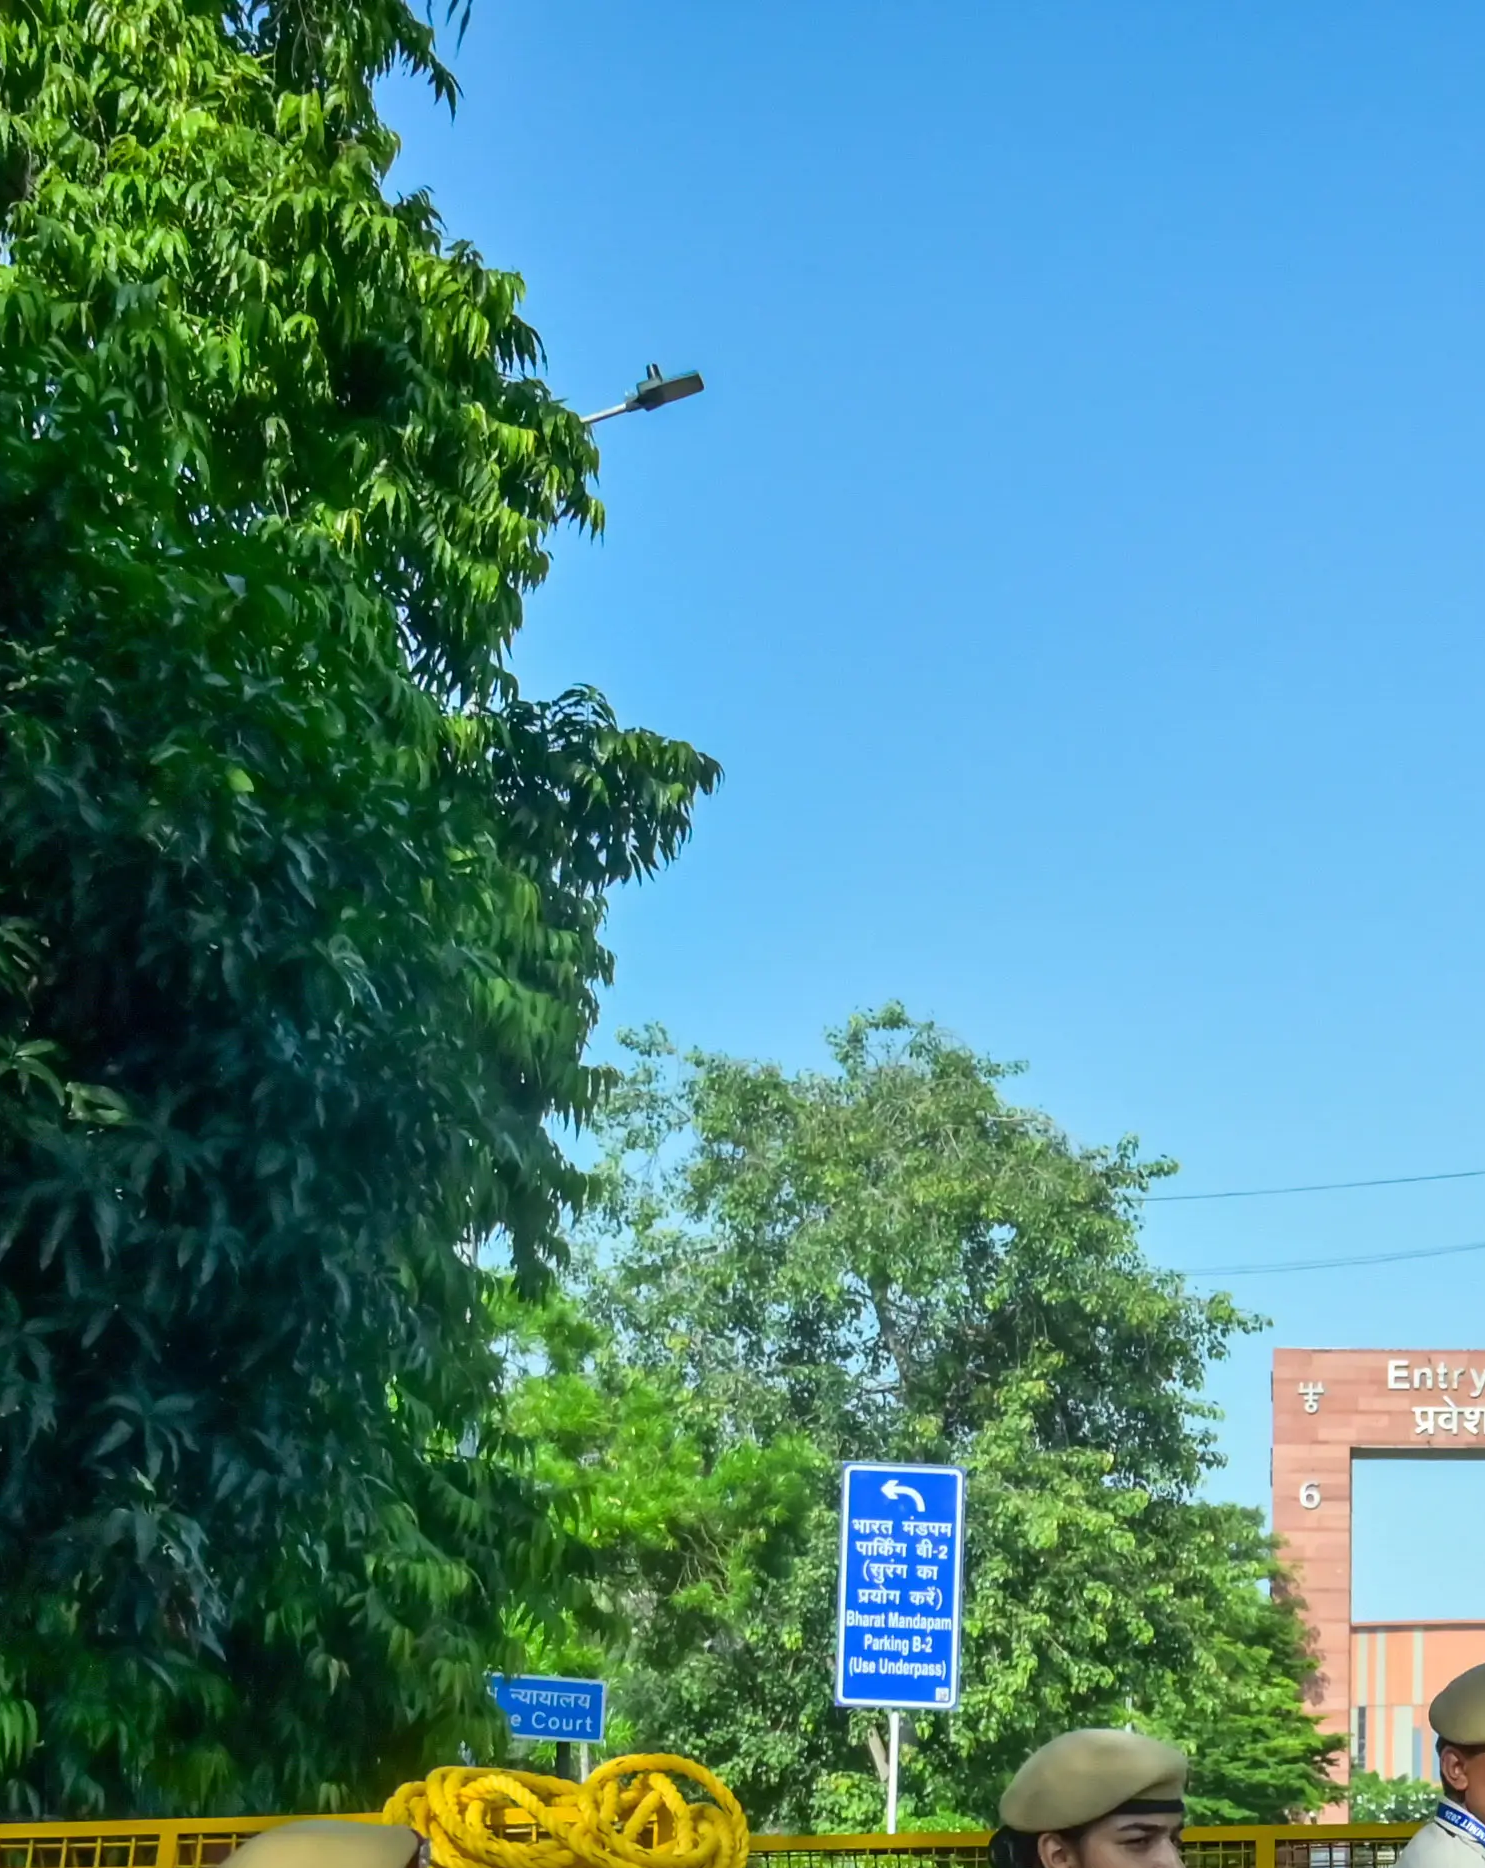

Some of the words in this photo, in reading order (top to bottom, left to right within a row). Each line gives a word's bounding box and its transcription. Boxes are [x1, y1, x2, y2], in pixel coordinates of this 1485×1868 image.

[1299, 1482, 1321, 1509] 6
[852, 1519, 893, 1535] भारत
[901, 1516, 952, 1537] मंडपम
[916, 1565, 938, 1580] का
[857, 1584, 900, 1605] प्रयोग
[846, 1609, 885, 1628] Bharat
[888, 1611, 952, 1634] Mandapam
[864, 1634, 909, 1656] Parking
[912, 1635, 933, 1653] B-2
[849, 1656, 876, 1677] (Use
[879, 1657, 946, 1680] Underpass)
[509, 1688, 591, 1709] न्यायालय
[531, 1711, 593, 1732] Court
